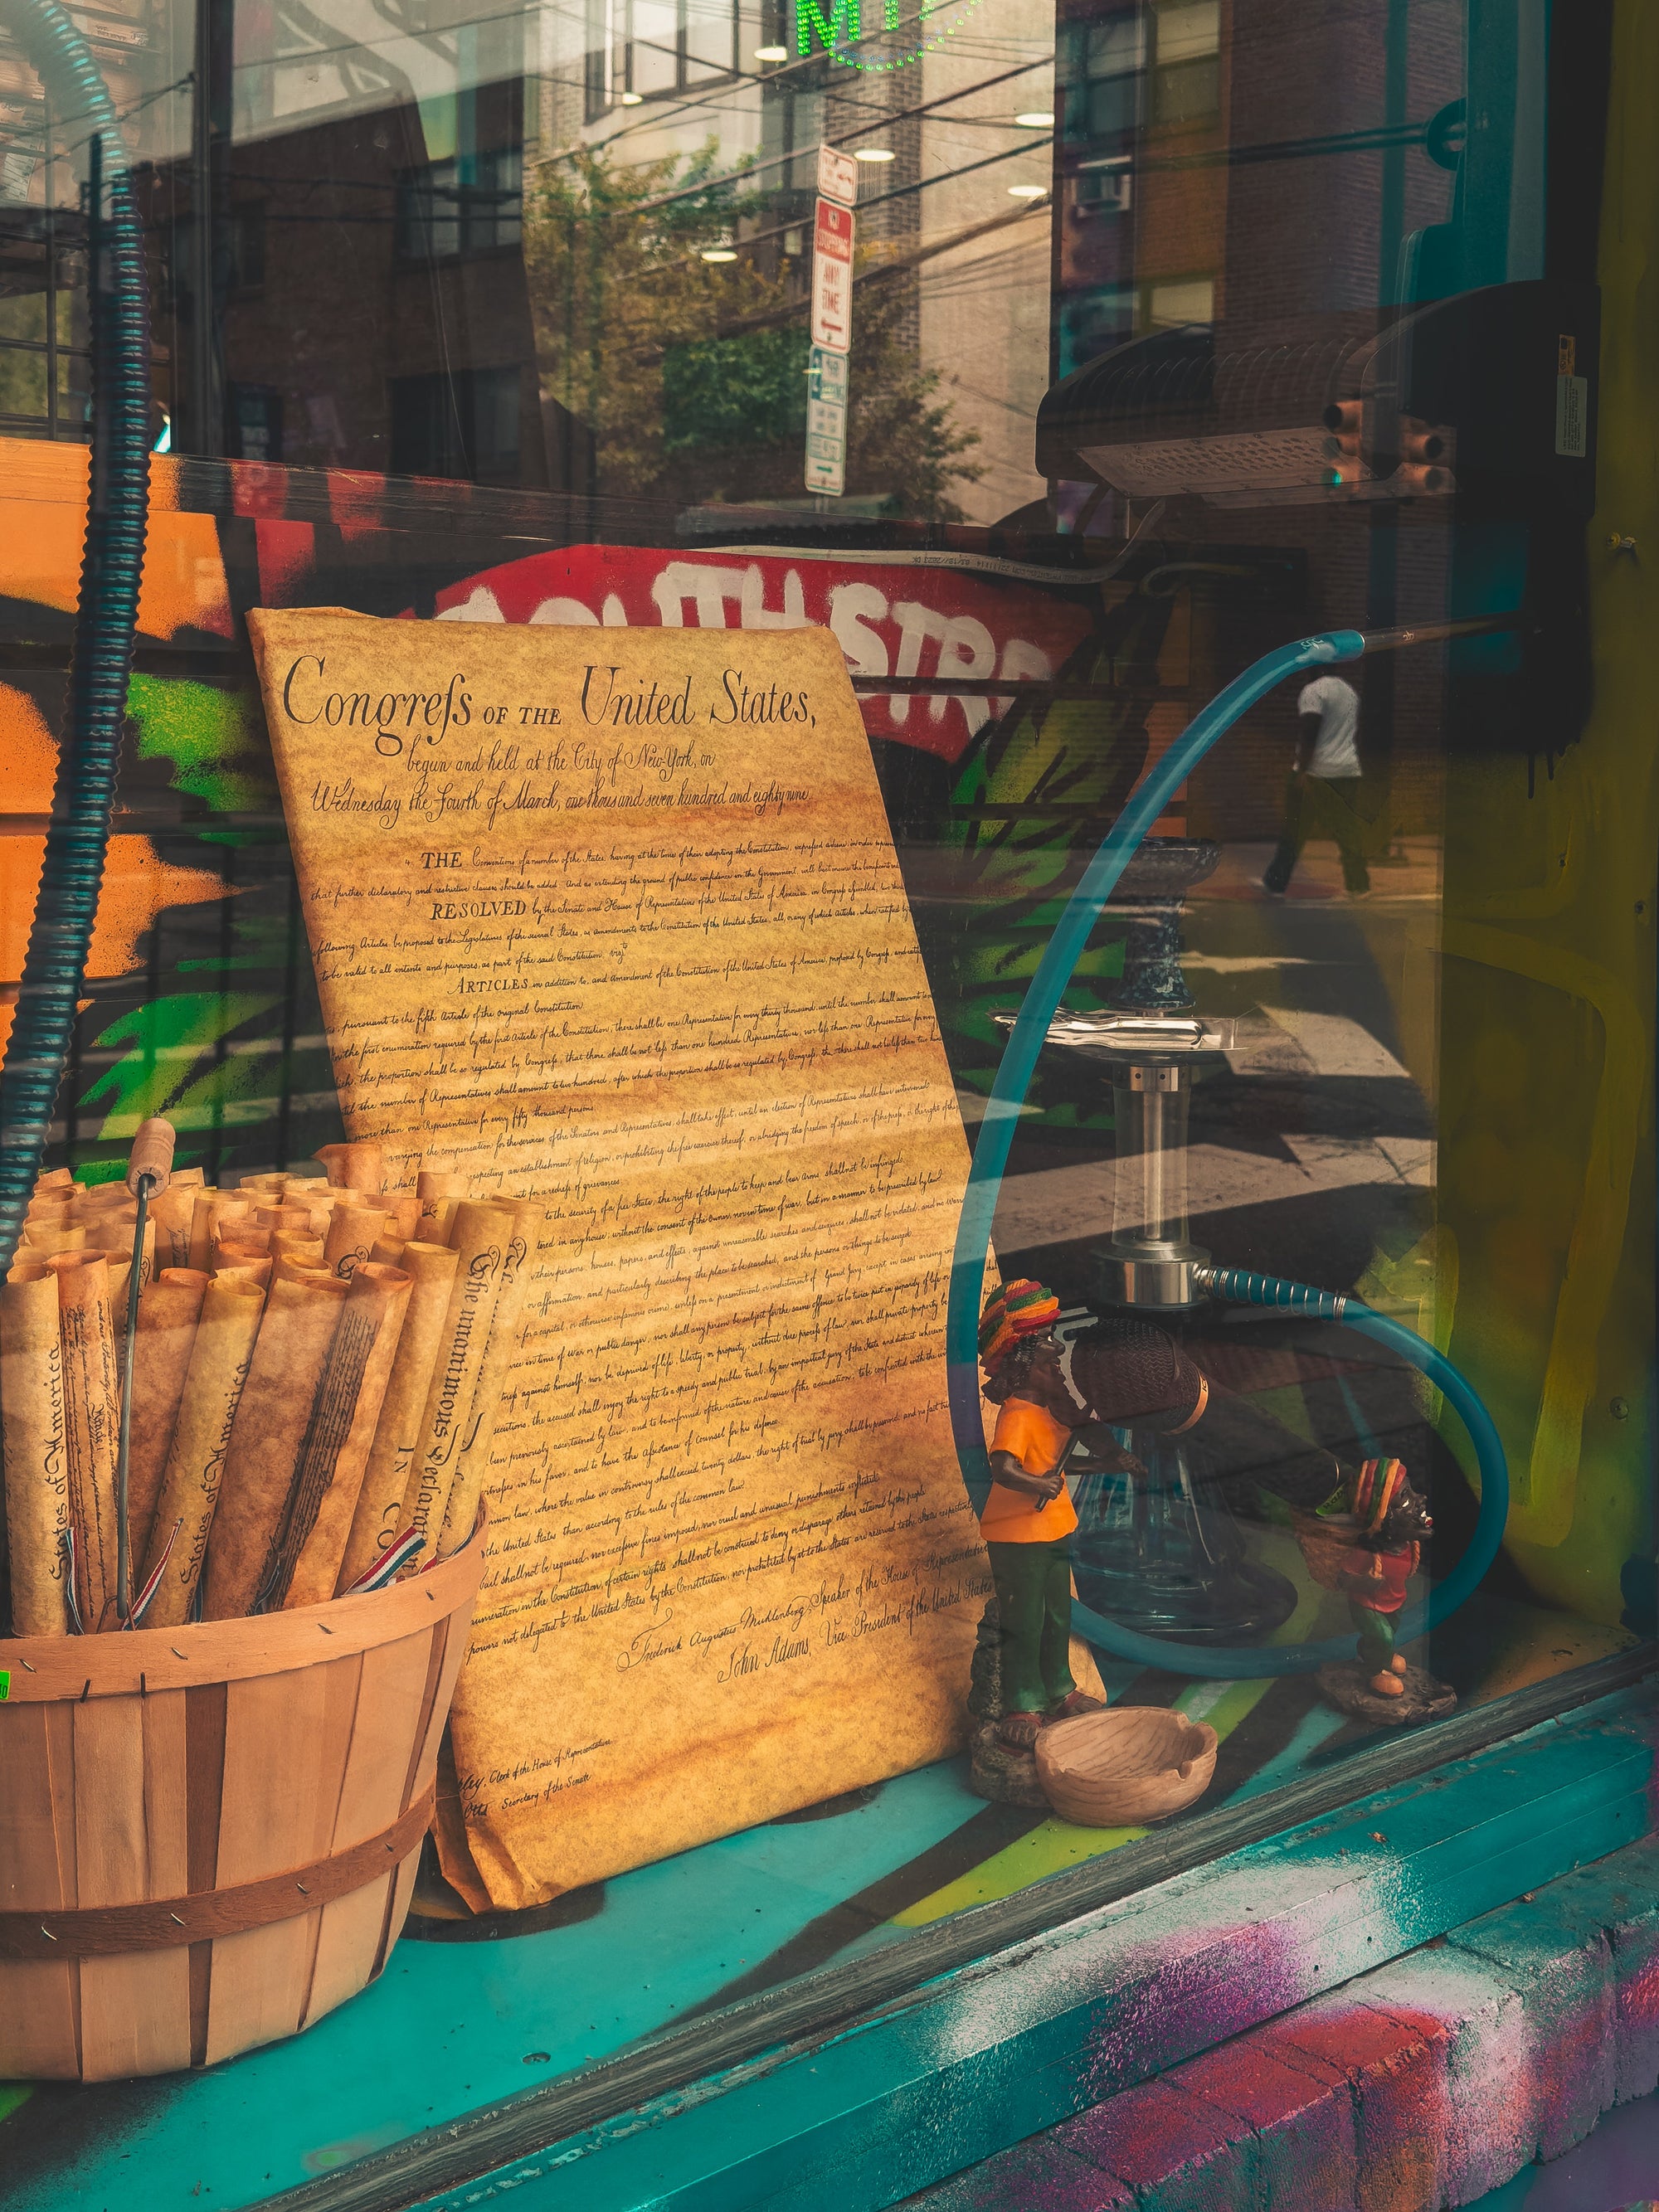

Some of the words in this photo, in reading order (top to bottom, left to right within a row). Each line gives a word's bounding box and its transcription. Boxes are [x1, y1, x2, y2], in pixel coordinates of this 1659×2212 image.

[484, 707, 508, 725] OF
[518, 707, 562, 725] THE
[581, 665, 695, 726] United
[709, 668, 816, 729] States,
[407, 734, 452, 794] begun
[456, 746, 484, 771] and
[488, 739, 519, 771] held
[527, 750, 544, 771] at
[547, 739, 567, 770] the
[572, 741, 602, 786] City
[607, 742, 624, 787] of
[700, 753, 716, 766] on
[311, 777, 401, 829] Wednesday
[409, 780, 433, 810] the
[425, 780, 484, 823] Fourth
[487, 780, 505, 831] of
[503, 780, 561, 811] March,
[566, 795, 584, 809] one
[586, 776, 645, 809] thousand
[645, 794, 674, 807] seven
[677, 778, 725, 805] hundred
[729, 781, 751, 802] and
[752, 780, 785, 816] eighty
[421, 852, 462, 869] THE
[611, 846, 635, 869] having
[687, 846, 703, 858] their
[705, 847, 734, 867] adopting
[334, 885, 363, 907] further
[368, 887, 411, 907] declaratory
[416, 883, 431, 895] and
[500, 878, 525, 891] should
[528, 880, 534, 888] be
[642, 874, 665, 895] ground
[430, 900, 526, 920] RESOLVED
[544, 902, 557, 913] the
[587, 902, 601, 912] and
[604, 898, 632, 912] House
[636, 898, 643, 920] of
[718, 892, 742, 902] United
[447, 976, 528, 995] ARTICLES
[592, 973, 607, 984] and
[465, 1244, 501, 1305] The
[433, 1309, 473, 1438] unanimous
[44, 1472, 66, 1495] of
[48, 1501, 71, 1580] States
[180, 1512, 212, 1585] States
[201, 1481, 220, 1503] of
[503, 1538, 531, 1552] United
[810, 1573, 850, 1616] Speaker
[502, 1631, 518, 1646] not
[717, 1641, 761, 1683] John
[851, 1603, 905, 1638] President
